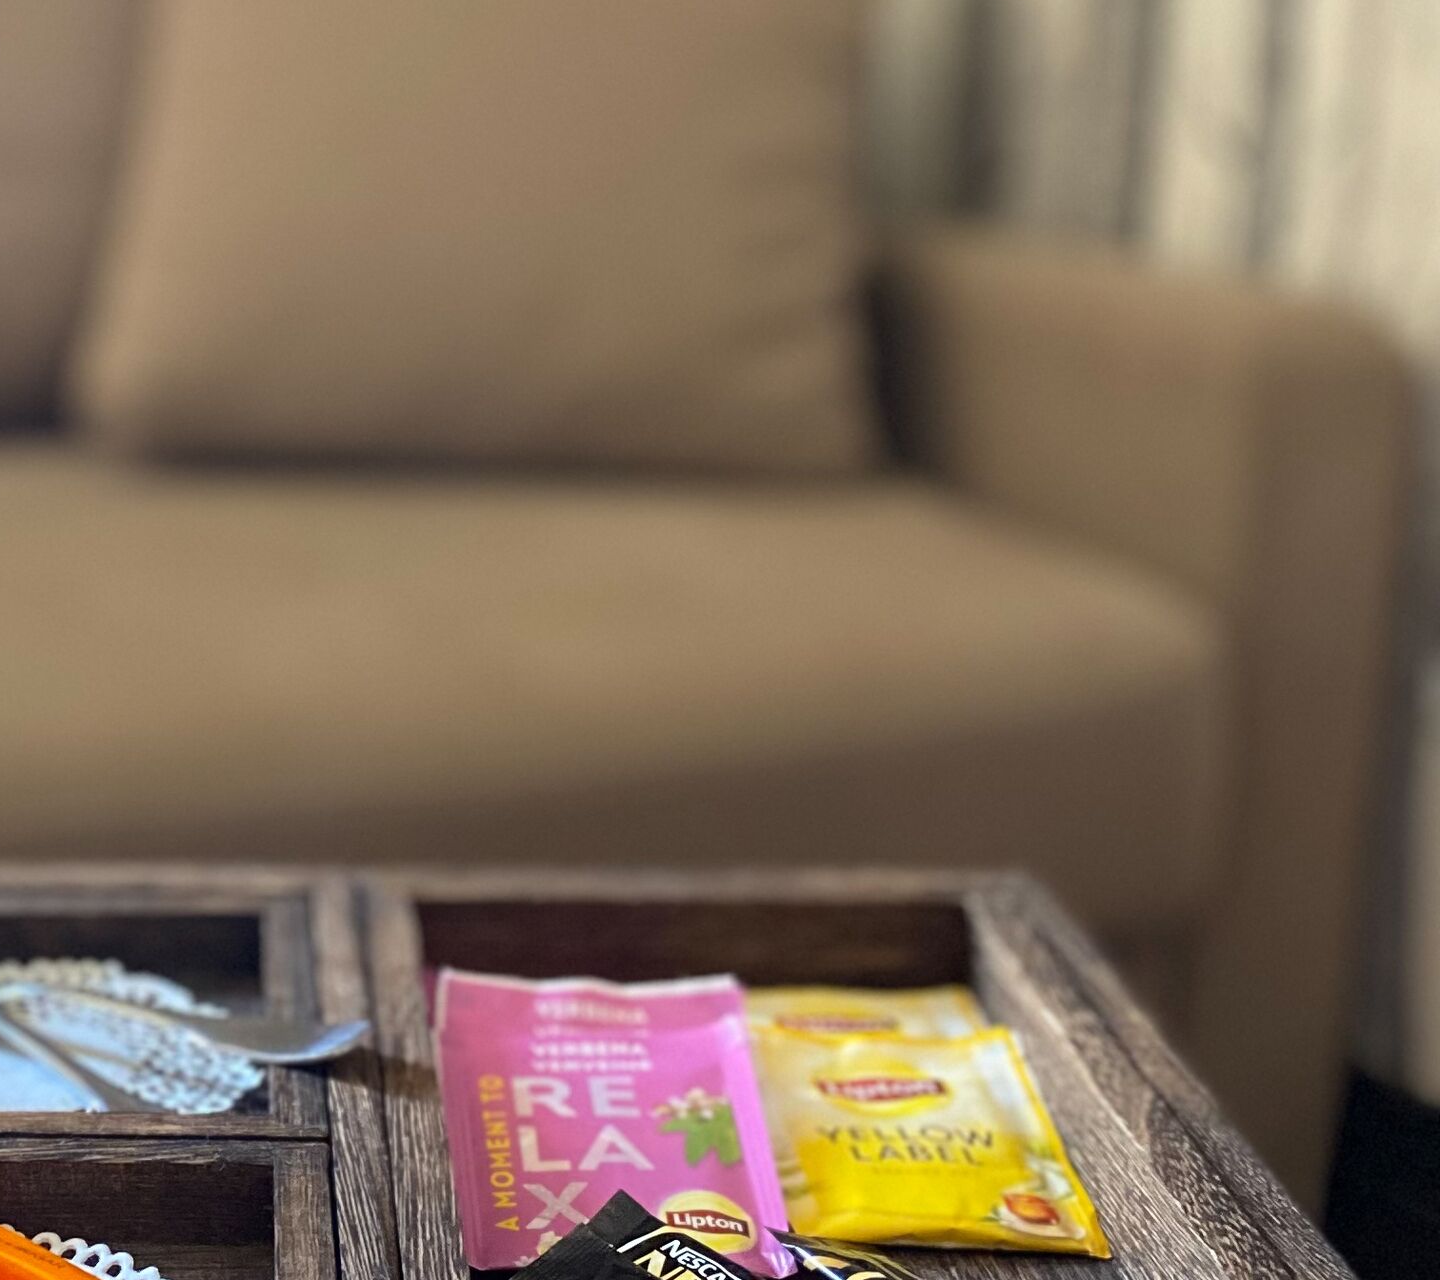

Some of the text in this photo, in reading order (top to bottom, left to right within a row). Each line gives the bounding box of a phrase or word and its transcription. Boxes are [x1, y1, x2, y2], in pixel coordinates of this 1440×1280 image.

[817, 1124, 994, 1148] YELLOW
[478, 1074, 520, 1231] A MOMENT TO
[850, 1144, 983, 1166] LABEL
[672, 1212, 744, 1233] Lipton
